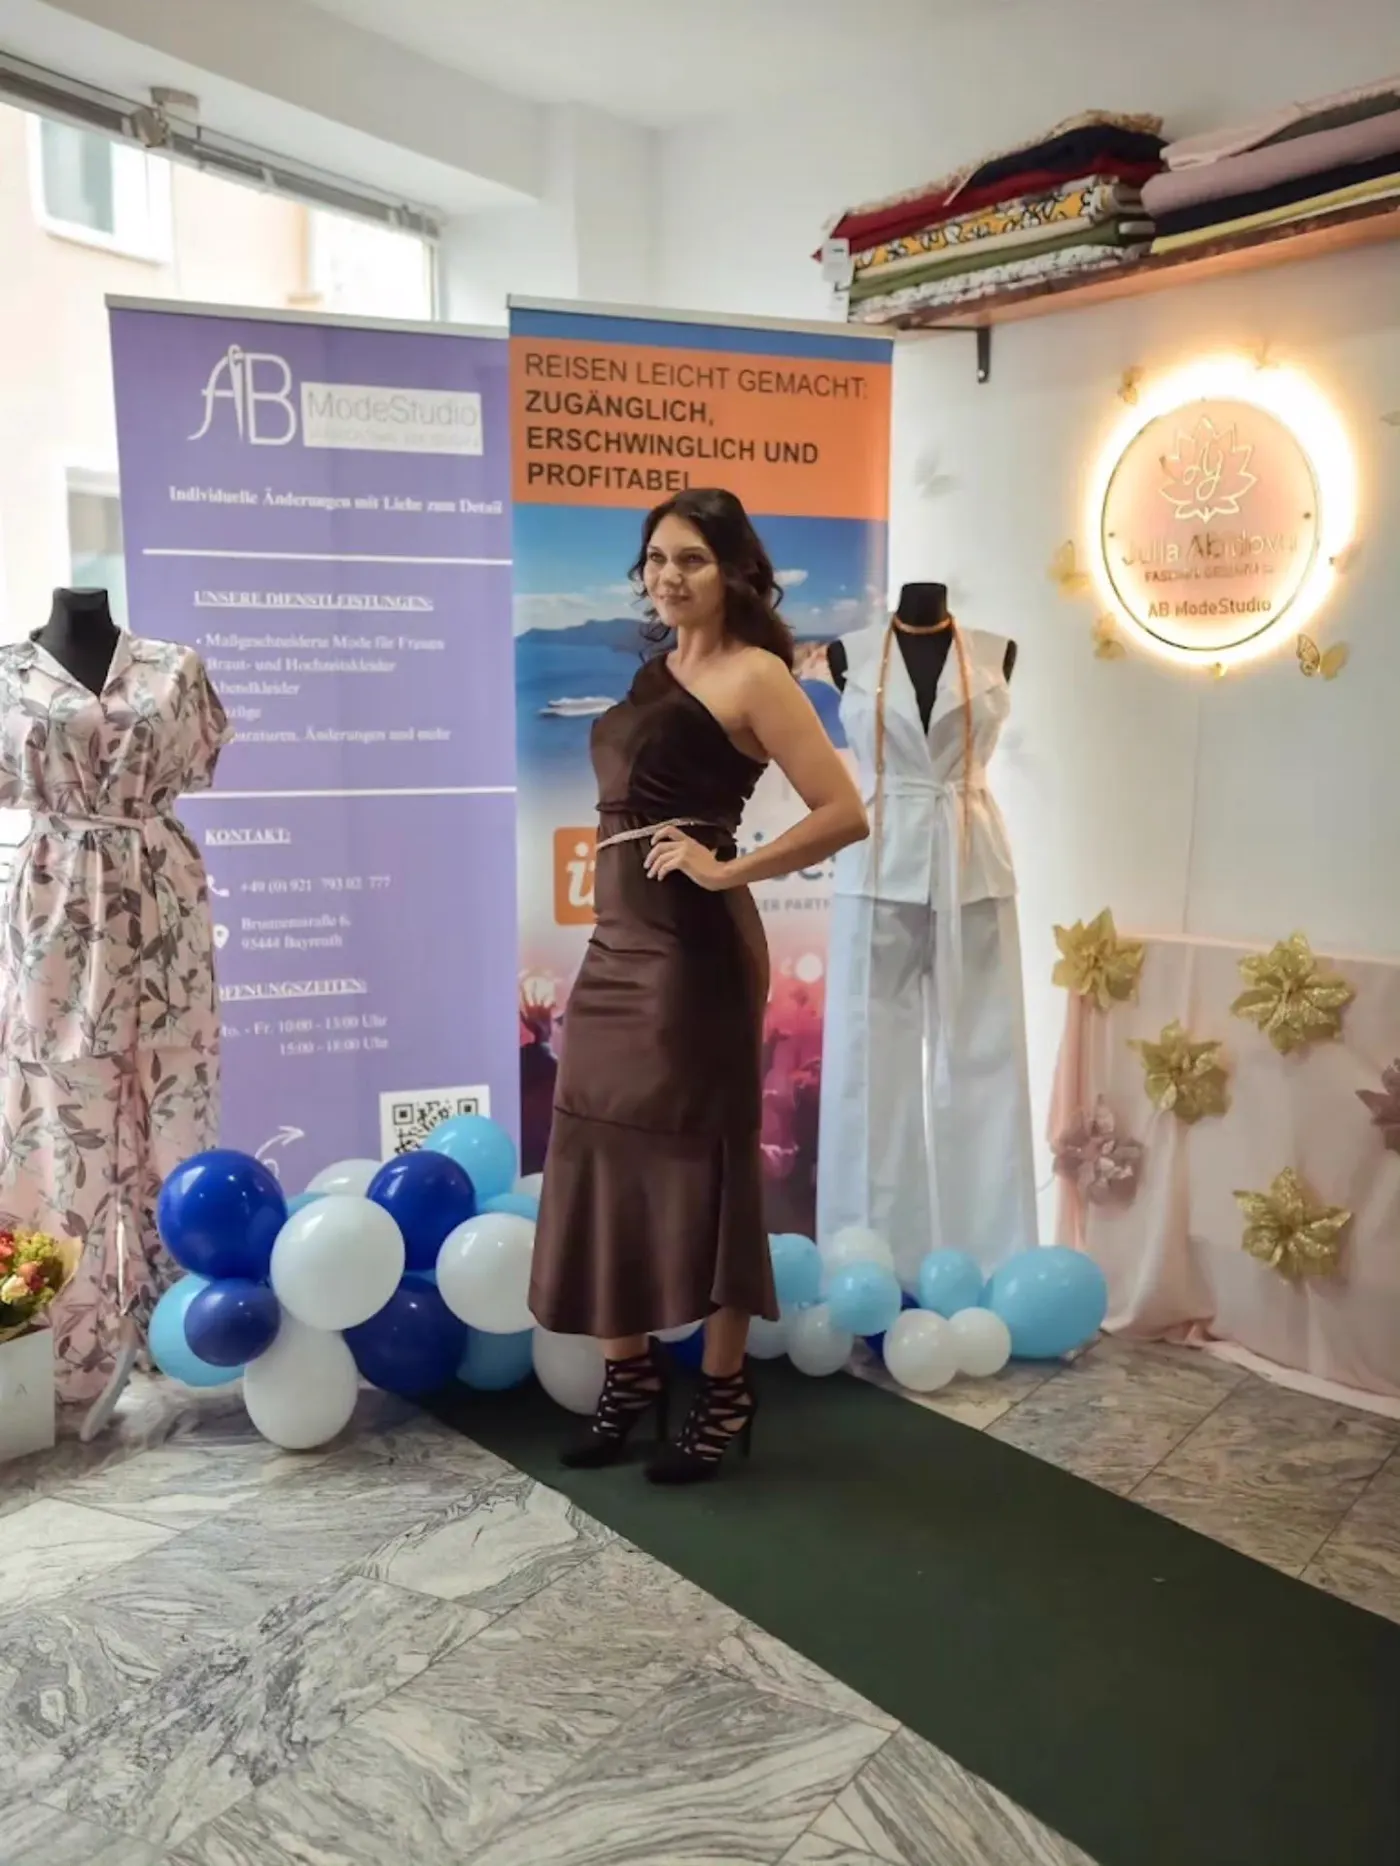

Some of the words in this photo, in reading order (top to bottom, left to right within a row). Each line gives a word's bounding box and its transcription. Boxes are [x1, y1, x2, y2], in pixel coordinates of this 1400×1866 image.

[525, 353, 627, 382] REISEN
[637, 361, 731, 390] LEICHT
[738, 369, 868, 400] GEMACHT:
[308, 391, 477, 427] ModeStudio
[525, 389, 714, 426] ZUGÄNGLICH,
[527, 426, 755, 461] ERSCHWINGLICH
[764, 441, 819, 465] UND
[168, 485, 259, 505] Individuelle
[263, 487, 351, 511] Änderungen
[355, 493, 379, 511] mit
[1148, 601, 1170, 619] AB
[1175, 597, 1272, 617] ModeStudio
